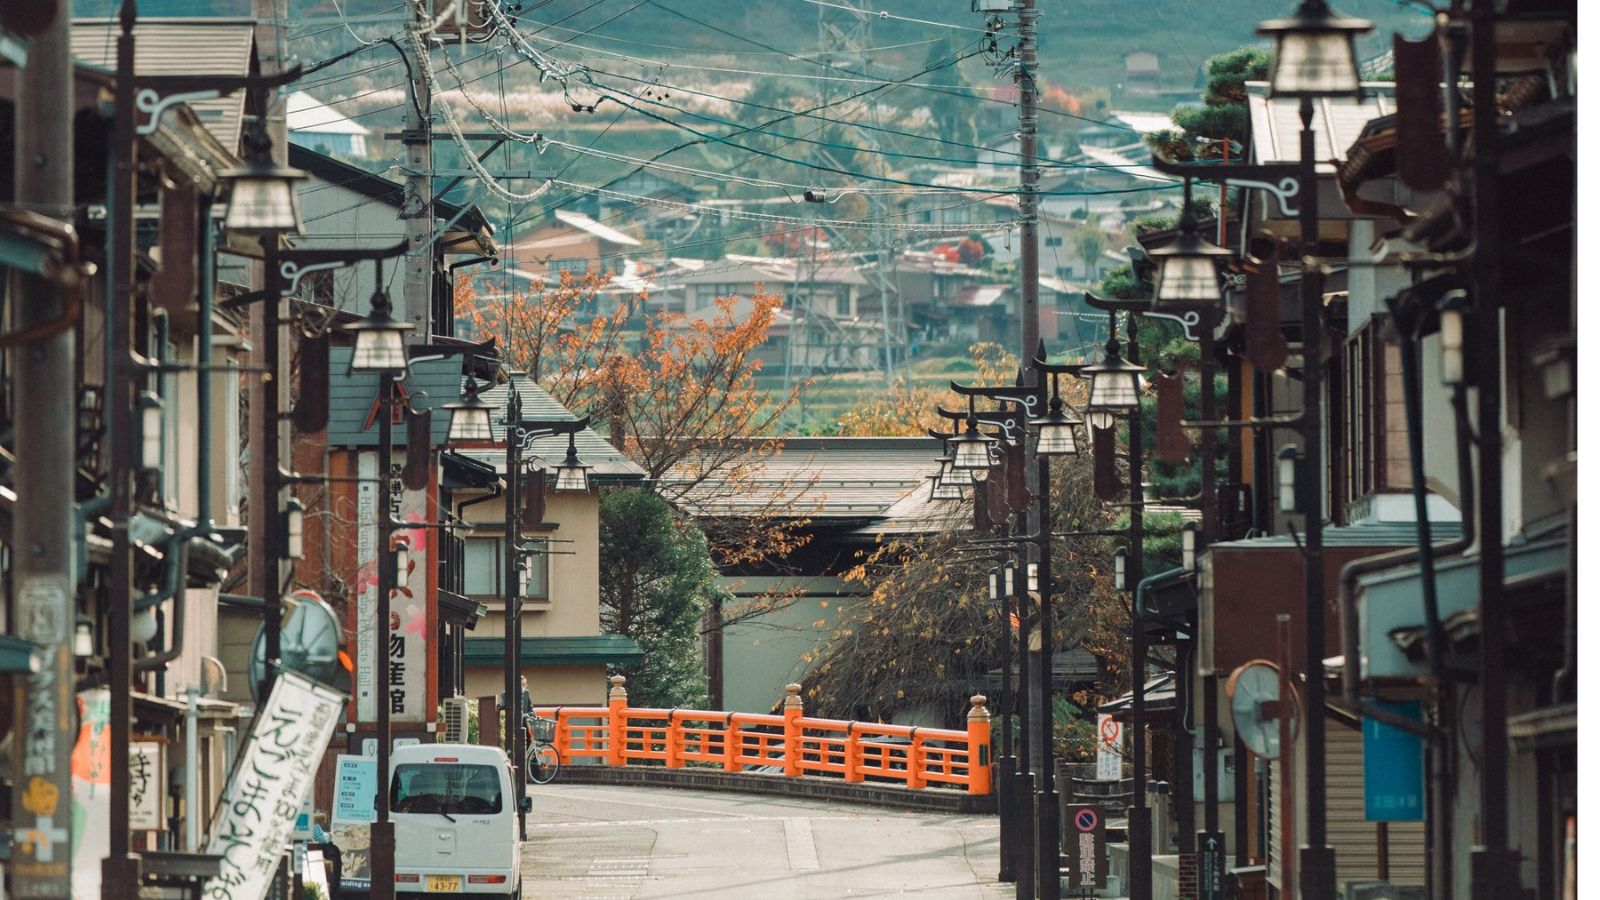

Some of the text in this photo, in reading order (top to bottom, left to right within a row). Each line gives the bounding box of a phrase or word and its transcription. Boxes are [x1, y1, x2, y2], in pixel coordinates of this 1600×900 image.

[359, 665, 372, 687] Hall
[1079, 832, 1096, 886] 駐車禁止
[434, 882, 458, 891] 43-77
